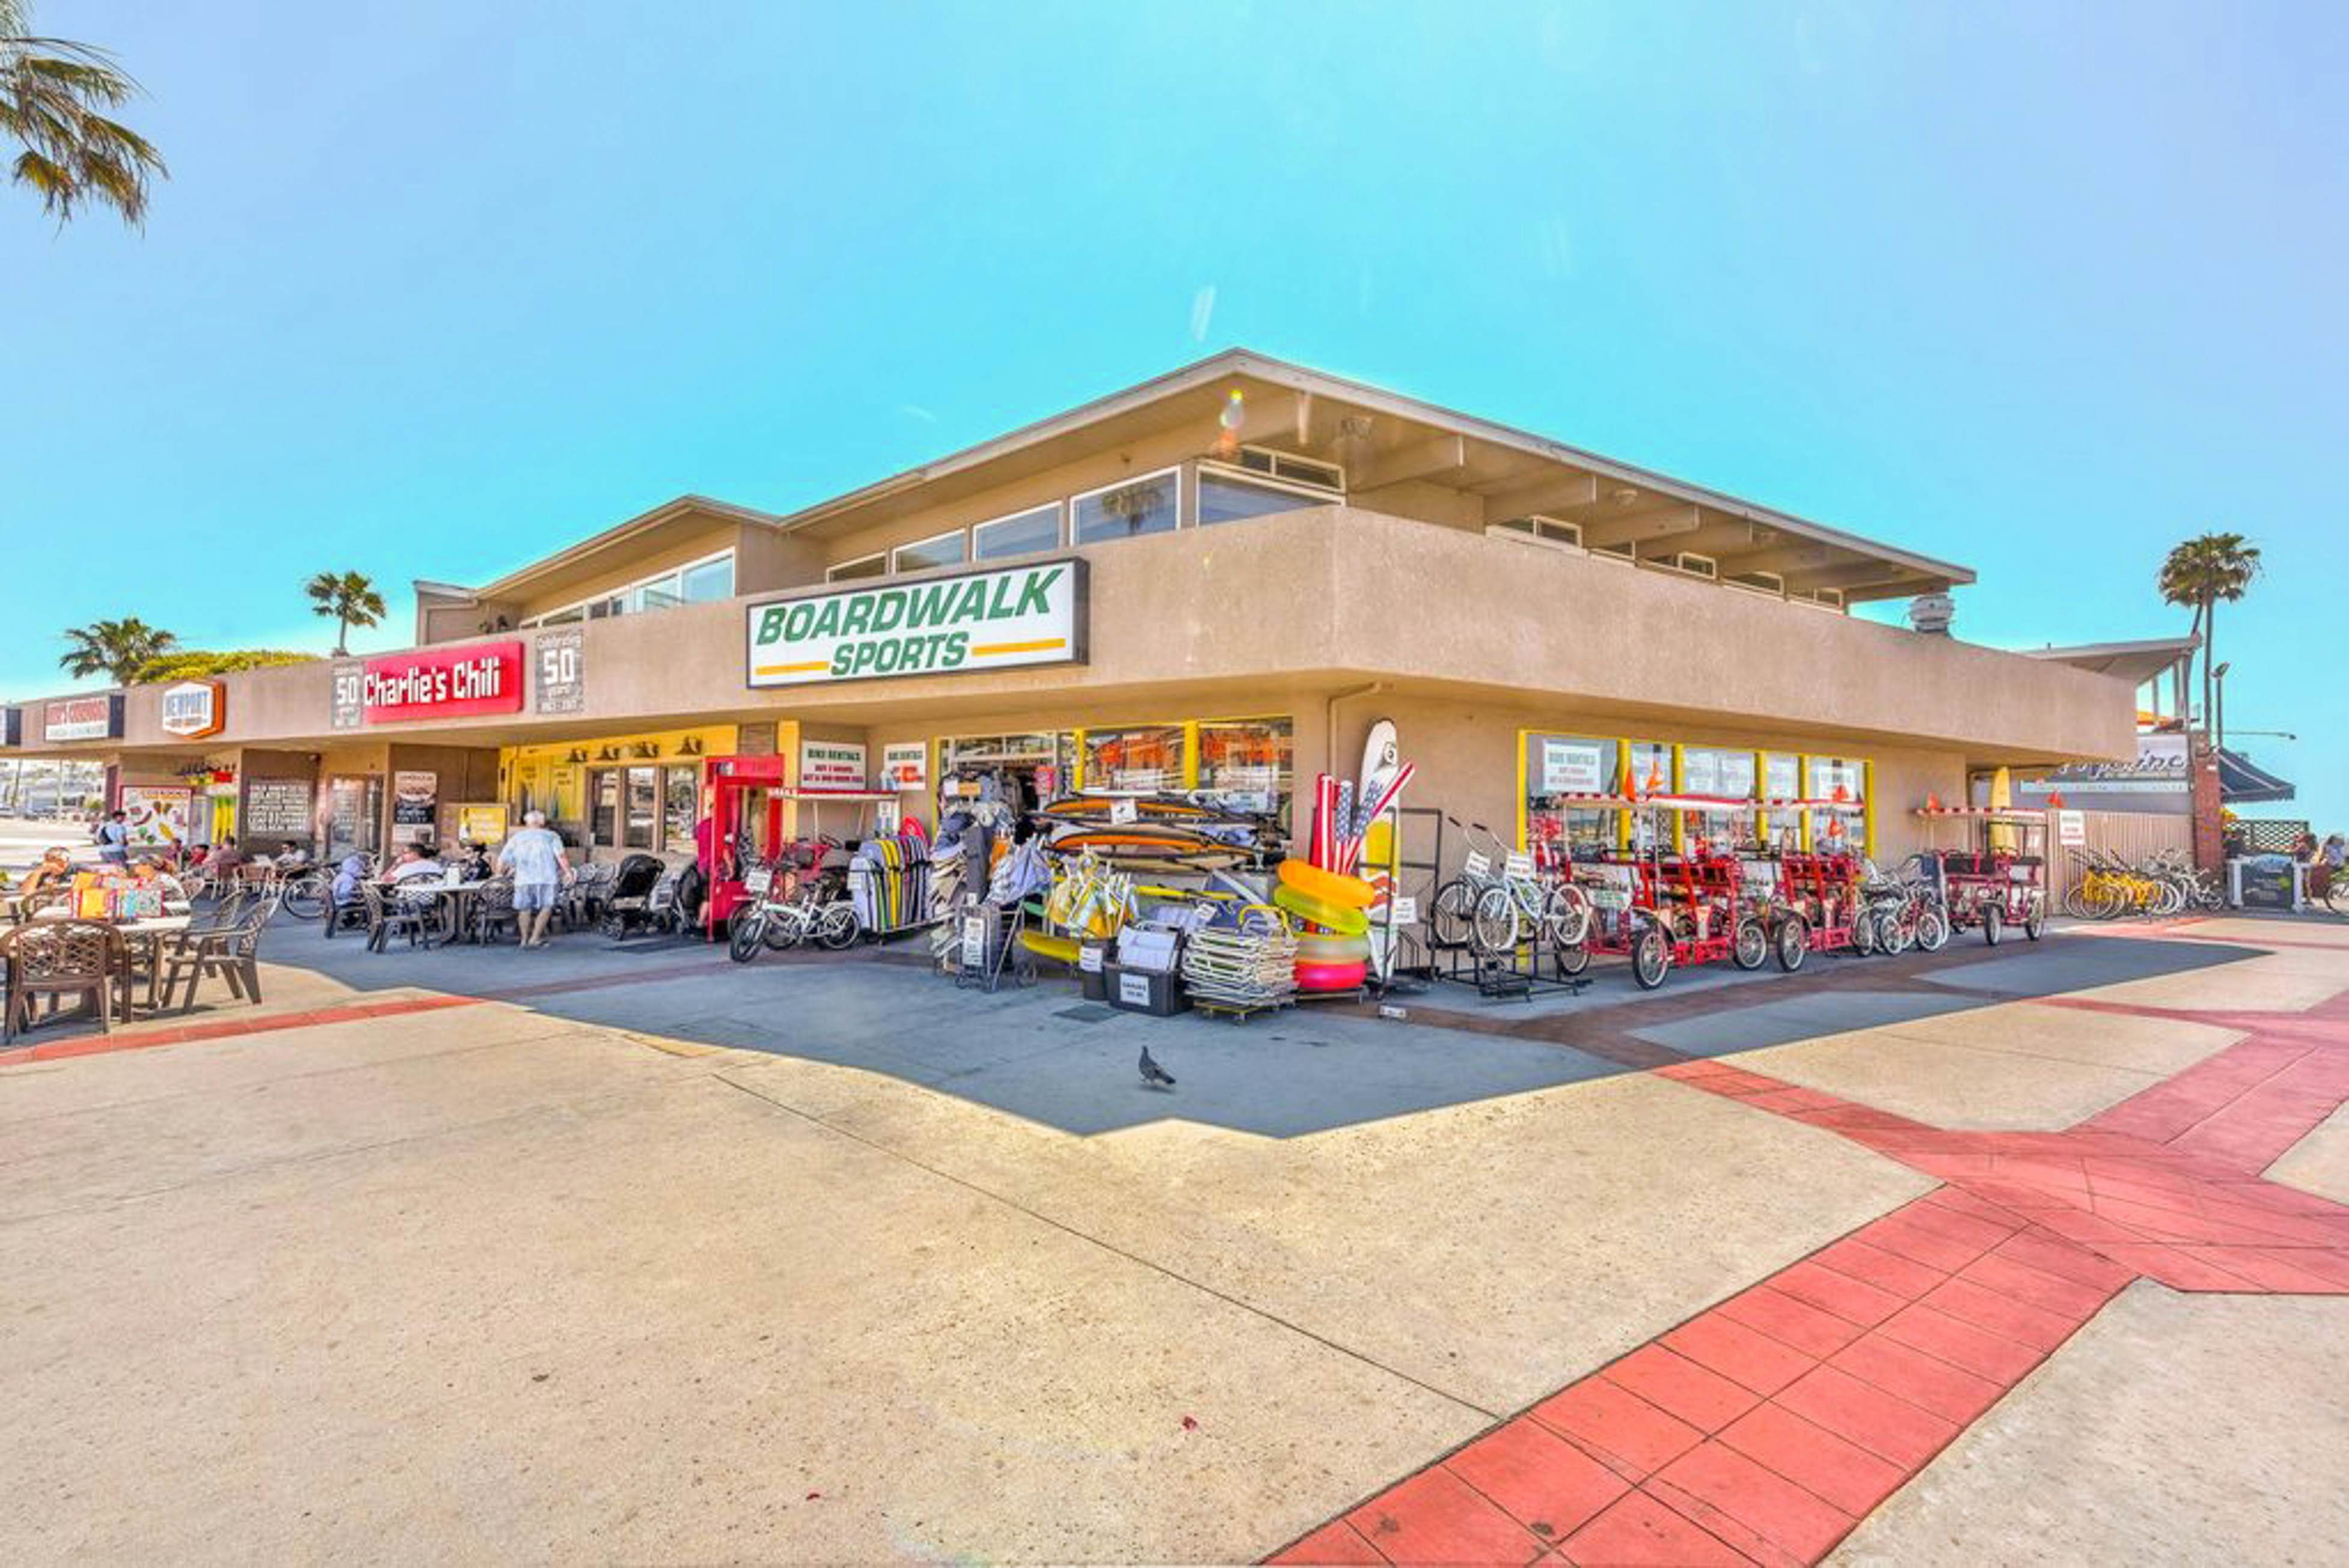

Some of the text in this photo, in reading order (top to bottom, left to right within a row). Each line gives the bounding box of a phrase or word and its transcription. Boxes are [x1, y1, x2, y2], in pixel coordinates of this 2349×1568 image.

[756, 568, 1064, 646] BOARDWALK
[544, 648, 575, 685] 50
[830, 631, 970, 676] SPORTS
[336, 676, 357, 705] 50
[364, 656, 500, 706] Charlie's Chili
[828, 750, 860, 761] RENTALS
